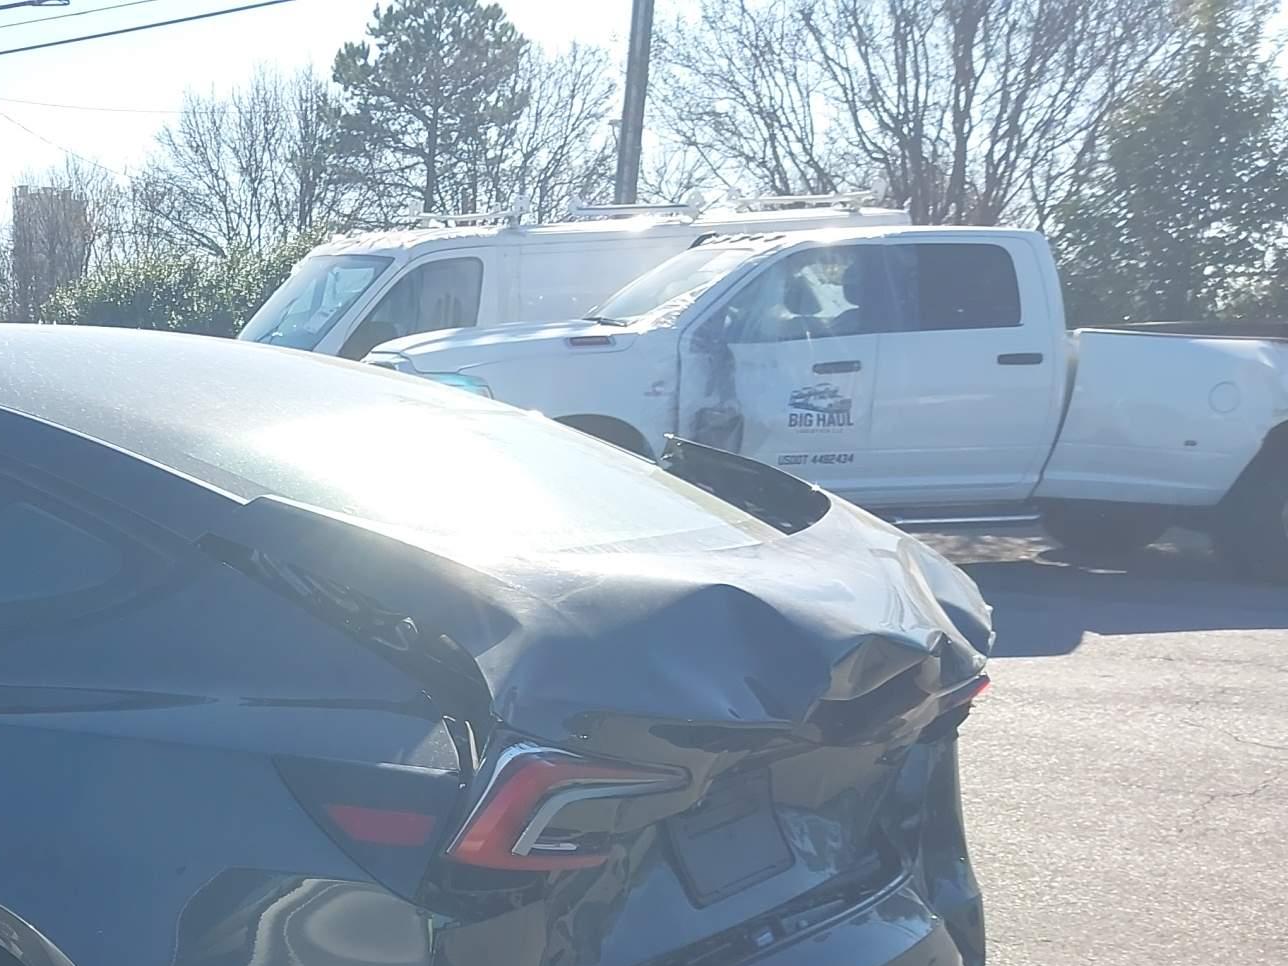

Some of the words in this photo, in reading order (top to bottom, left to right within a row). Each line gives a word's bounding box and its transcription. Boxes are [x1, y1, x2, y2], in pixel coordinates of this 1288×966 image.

[788, 412, 813, 427] BIG
[816, 412, 854, 427] HAUL
[777, 454, 809, 465] USDOT
